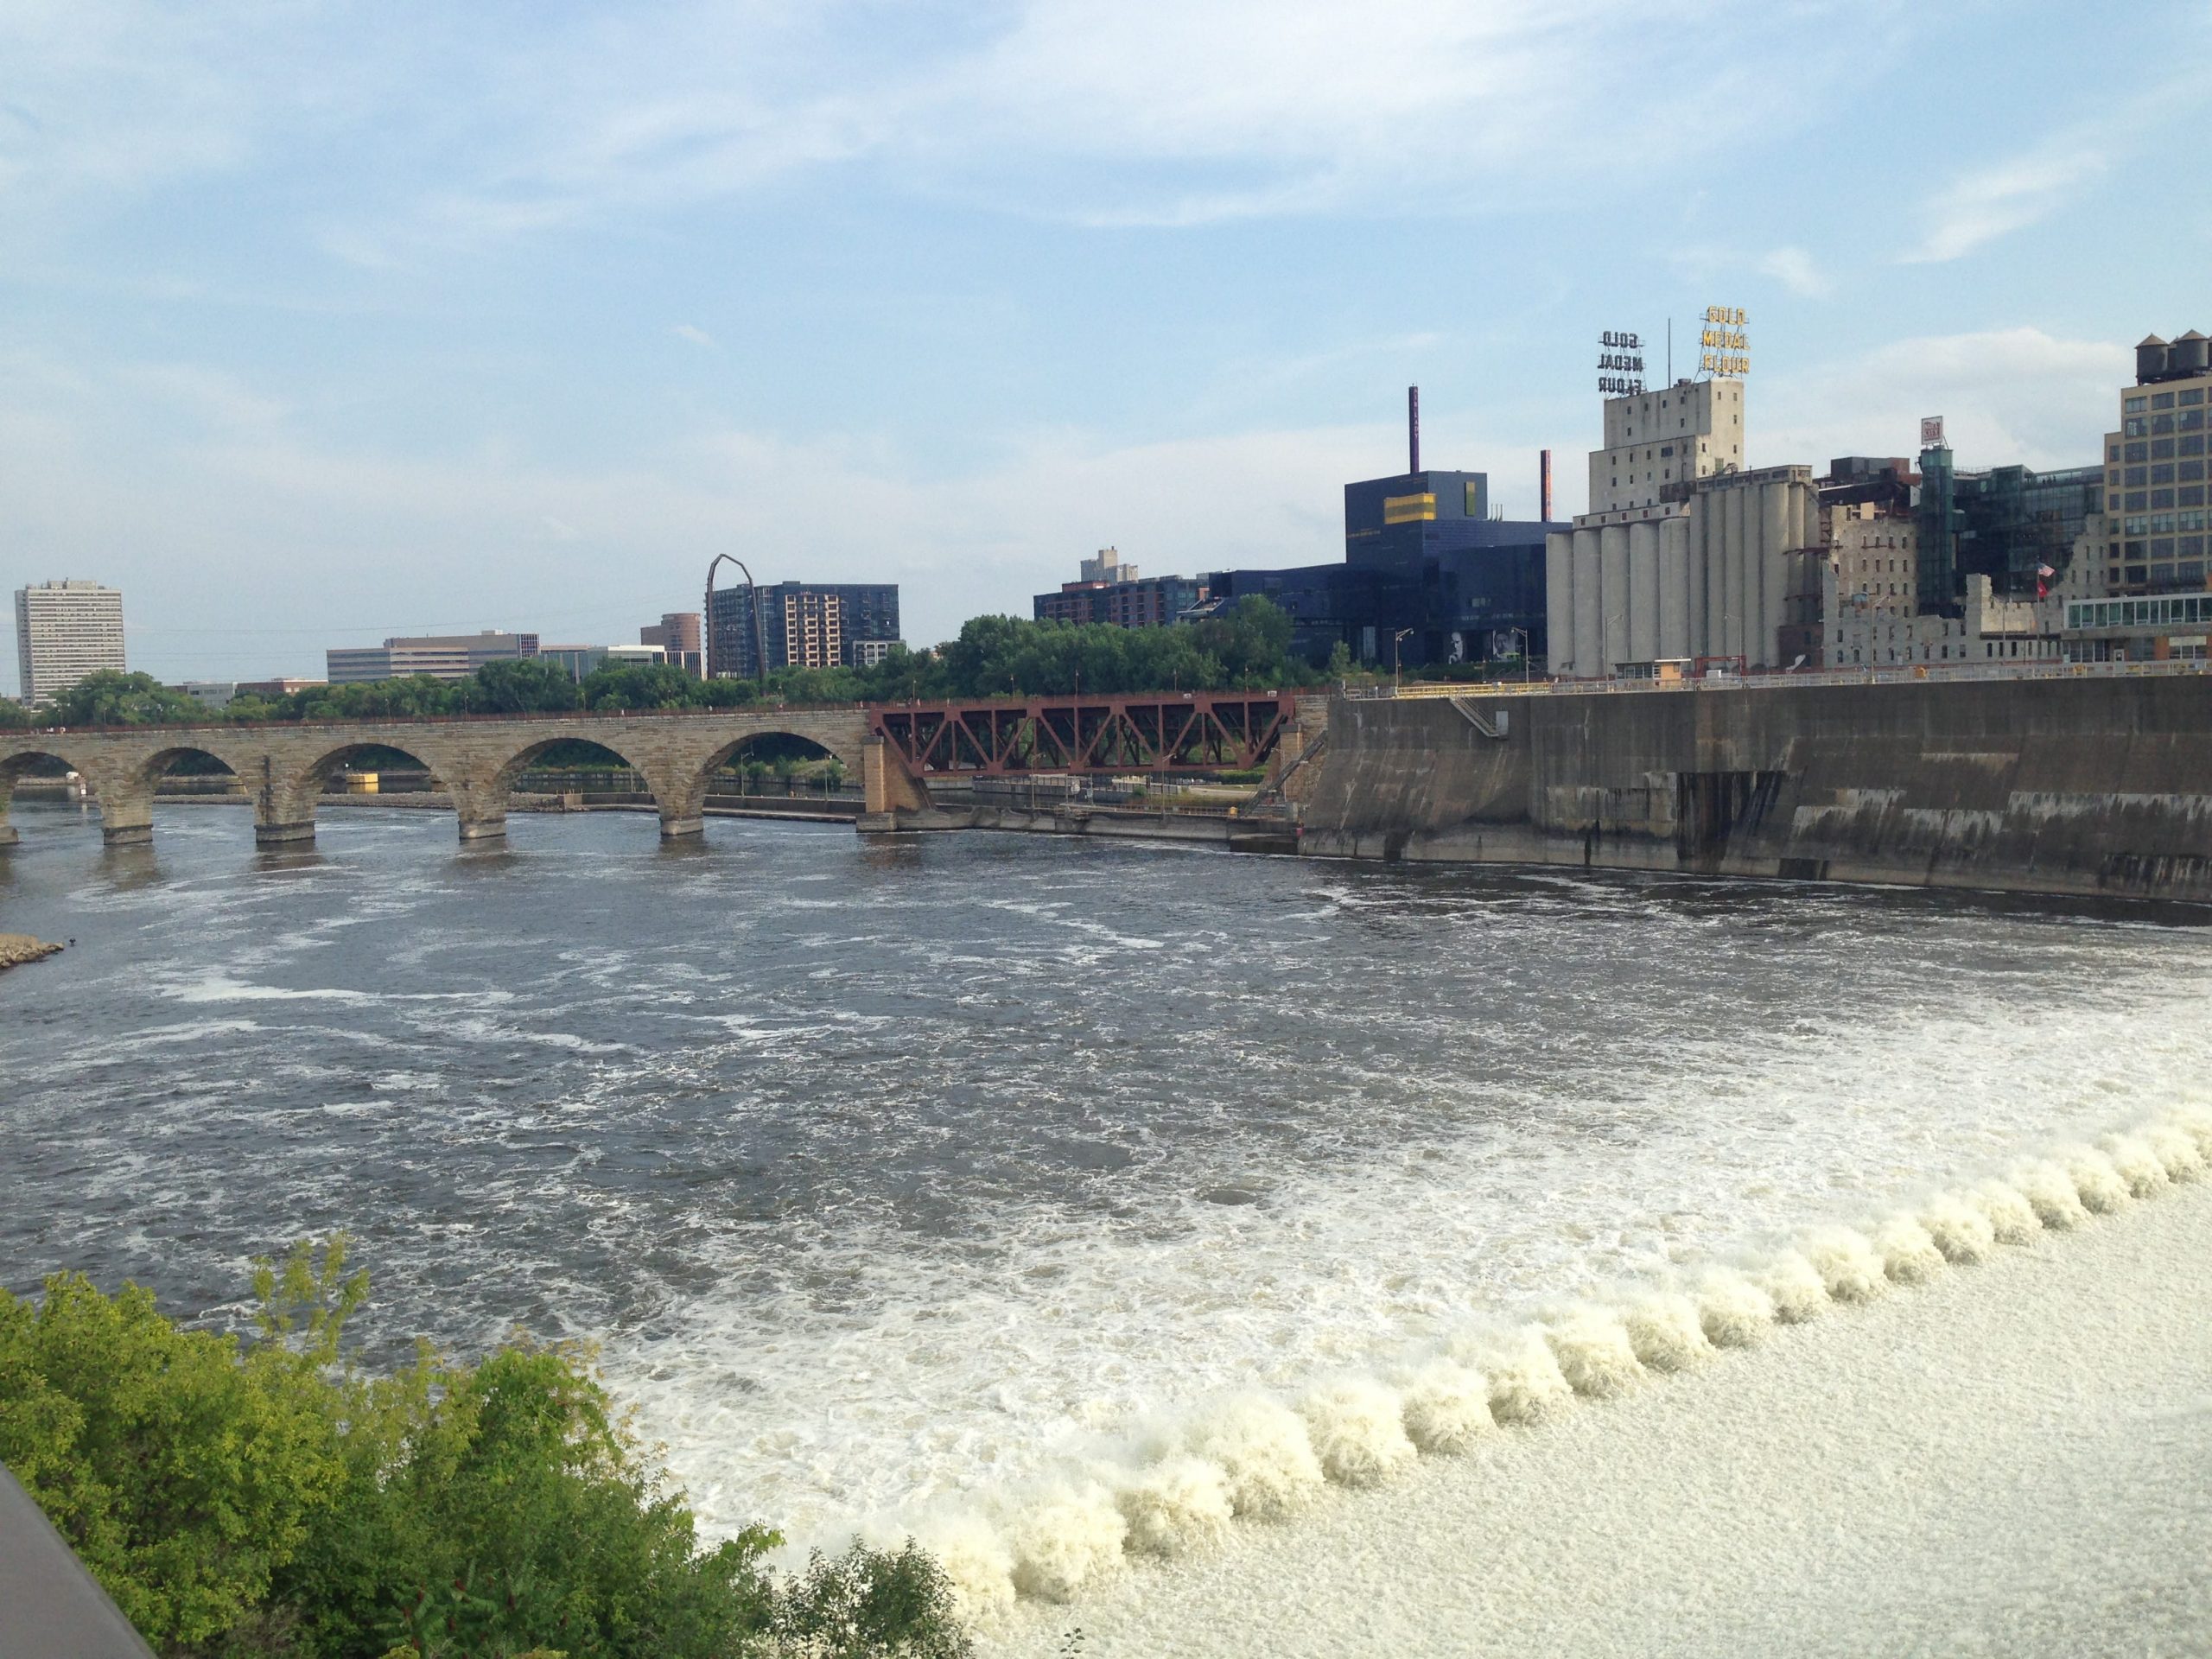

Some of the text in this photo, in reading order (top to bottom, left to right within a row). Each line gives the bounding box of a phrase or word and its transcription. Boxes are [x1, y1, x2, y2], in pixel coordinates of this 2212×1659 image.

[1707, 305, 1745, 326] GOLD
[1702, 330, 1751, 350] MEDAL
[1703, 354, 1750, 374] FLOUR
